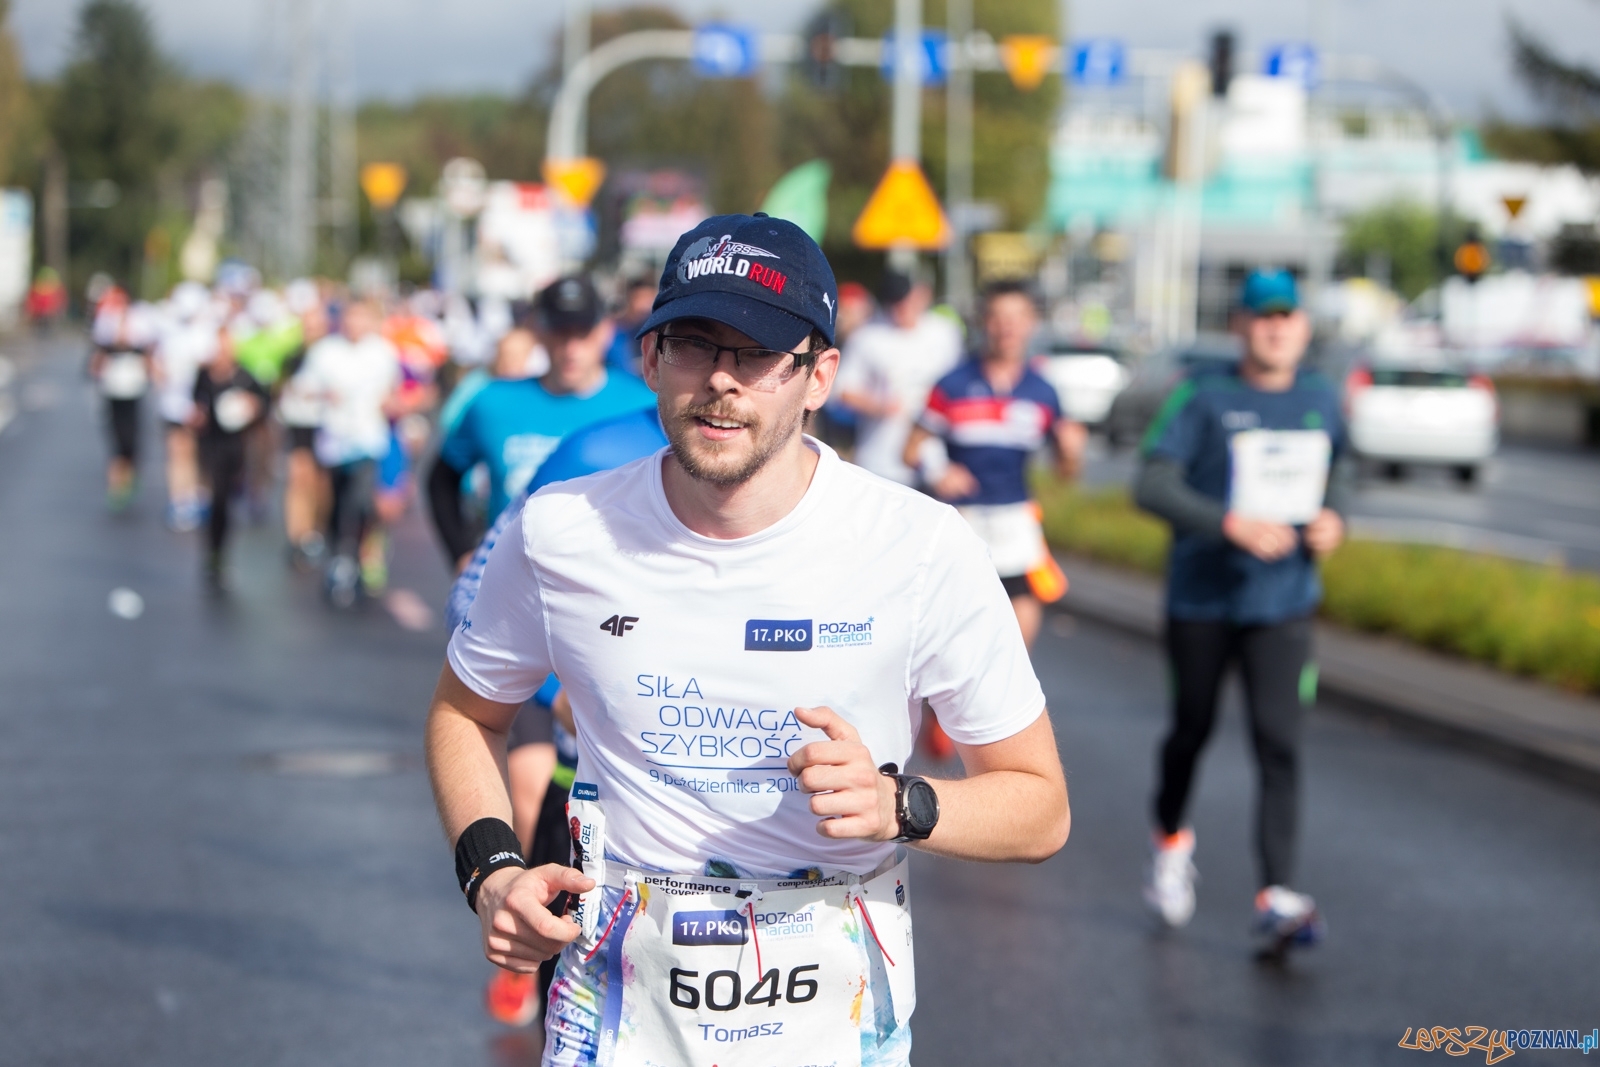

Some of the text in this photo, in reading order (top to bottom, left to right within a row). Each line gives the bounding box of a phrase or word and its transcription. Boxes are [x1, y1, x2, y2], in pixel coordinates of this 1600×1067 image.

[687, 258, 787, 295] WORLD RUN
[600, 614, 640, 637] 4F
[752, 629, 807, 642] 17. PKO
[819, 632, 872, 644] maraton
[637, 674, 703, 699] SIŁA
[659, 705, 802, 731] ODWAGA
[641, 732, 802, 758] SZYBKOŚĆ
[649, 769, 660, 782] 9
[577, 789, 597, 797] DURING
[581, 823, 592, 845] GEL
[644, 876, 731, 894] performance
[777, 876, 836, 888] compressport
[680, 919, 742, 936] 17. PKO
[669, 963, 820, 1012] 6046
[698, 1022, 785, 1043] Tomasz
